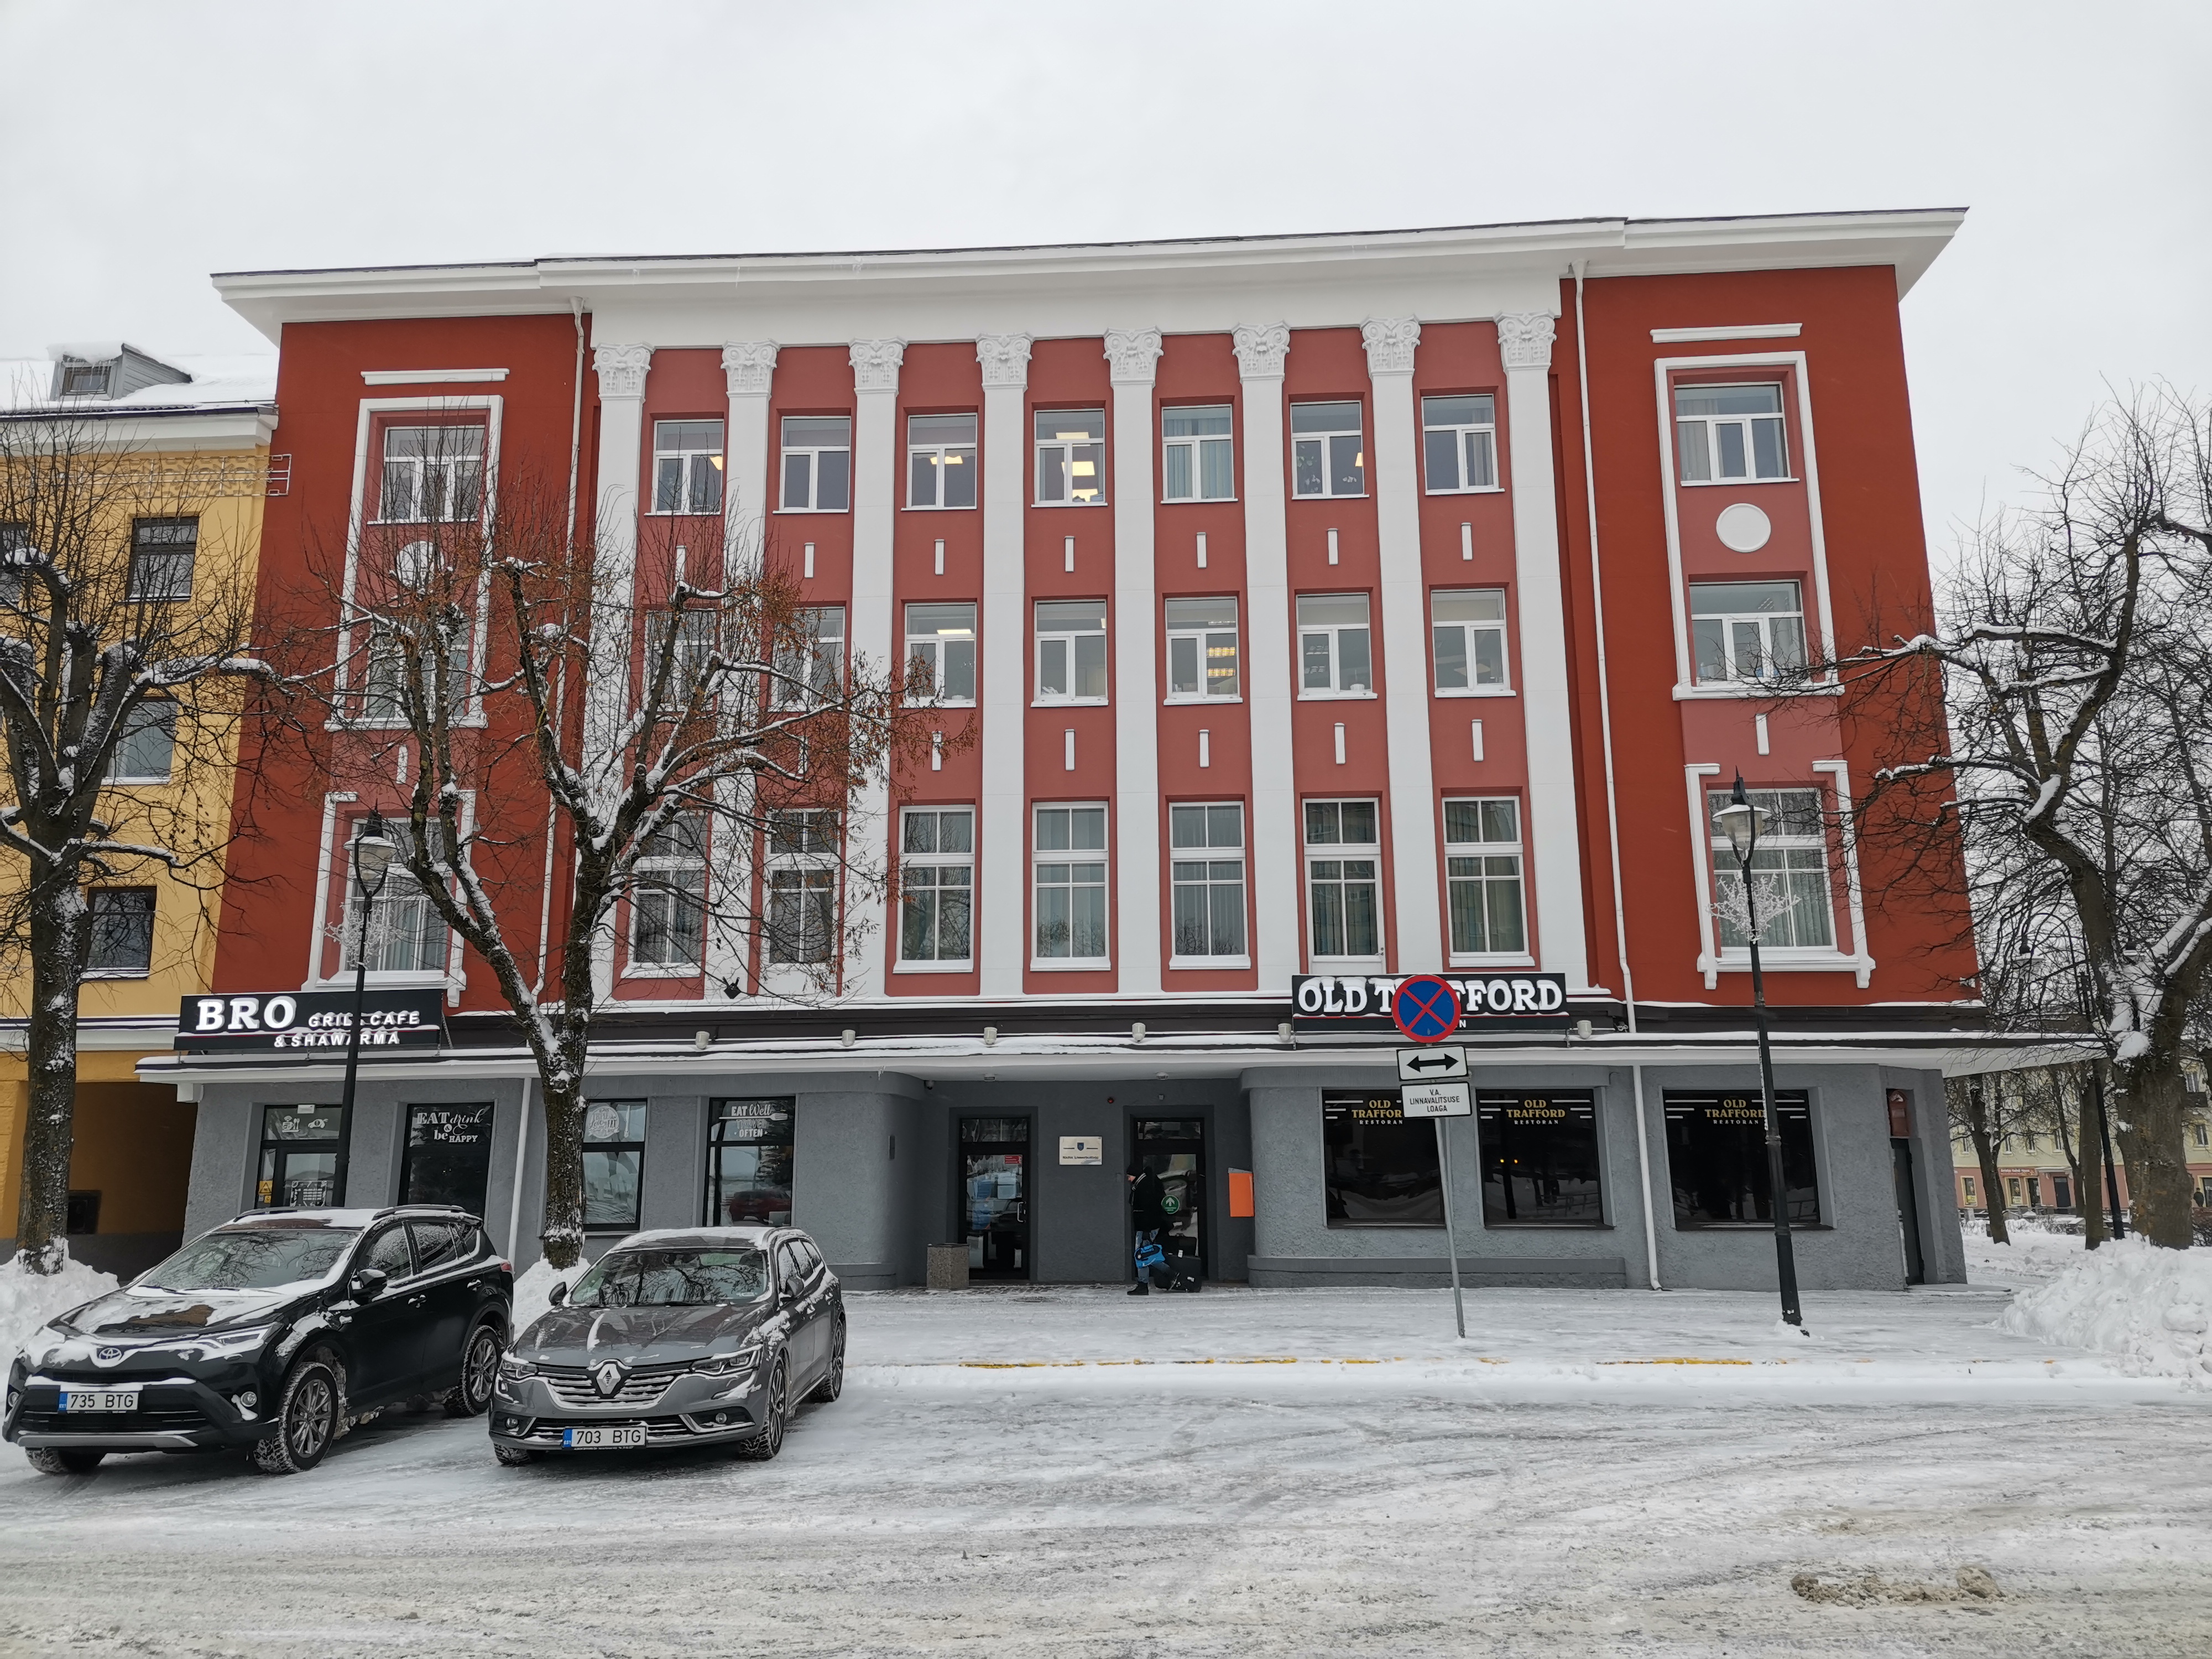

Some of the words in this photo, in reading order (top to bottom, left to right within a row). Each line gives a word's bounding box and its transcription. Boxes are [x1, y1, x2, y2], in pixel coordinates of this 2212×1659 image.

[1298, 984, 1368, 1013] OLD
[1374, 983, 1563, 1013] TFORD
[195, 997, 296, 1031] BRO
[308, 1014, 364, 1027] GRIL
[370, 1013, 419, 1026] CAFE
[274, 1036, 285, 1047] &
[1369, 1099, 1391, 1109] OLD
[1409, 1095, 1460, 1105] LINNAVALITSUSE
[1524, 1099, 1547, 1108] OLD
[1723, 1099, 1746, 1108] OLD
[731, 1106, 748, 1116] EAT
[749, 1104, 771, 1116] Well
[1351, 1109, 1402, 1118] TRAFFOR
[1506, 1109, 1566, 1118] TRAFFORD
[1704, 1109, 1764, 1118] TRAFFORD
[417, 1112, 450, 1124] EAT
[450, 1108, 484, 1129] drink
[434, 1129, 448, 1140] be
[448, 1135, 478, 1143] HAPPY
[739, 1128, 763, 1138] OFTEN
[70, 1394, 95, 1408] 735
[105, 1394, 134, 1408] BTG
[576, 1430, 601, 1444] 703
[613, 1430, 641, 1443] BTG
